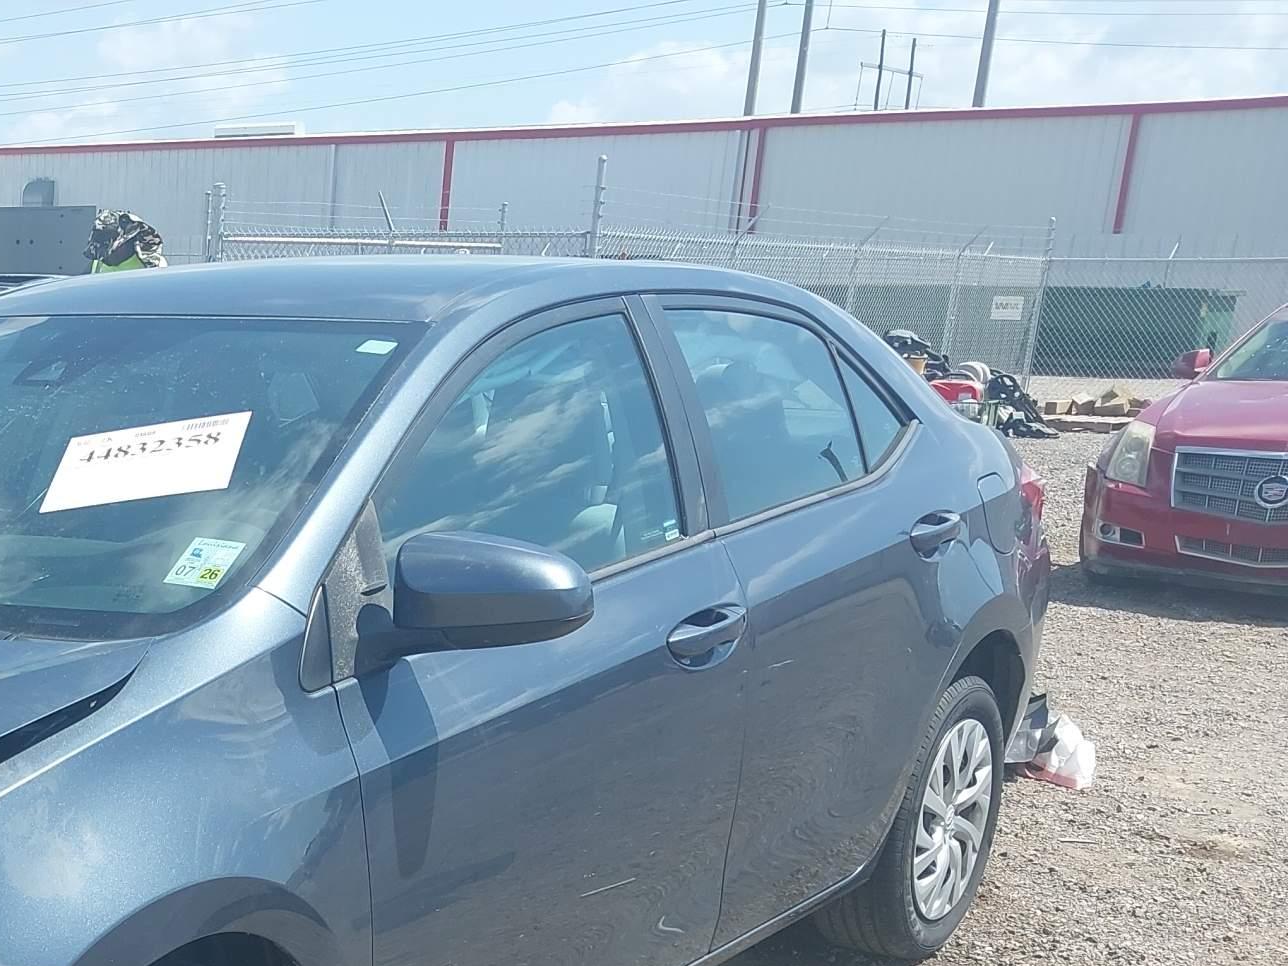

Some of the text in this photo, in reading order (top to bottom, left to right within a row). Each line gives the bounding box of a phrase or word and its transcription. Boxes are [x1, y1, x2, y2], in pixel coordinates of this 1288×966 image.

[79, 431, 222, 463] 44832358
[175, 564, 221, 580] 07 26
